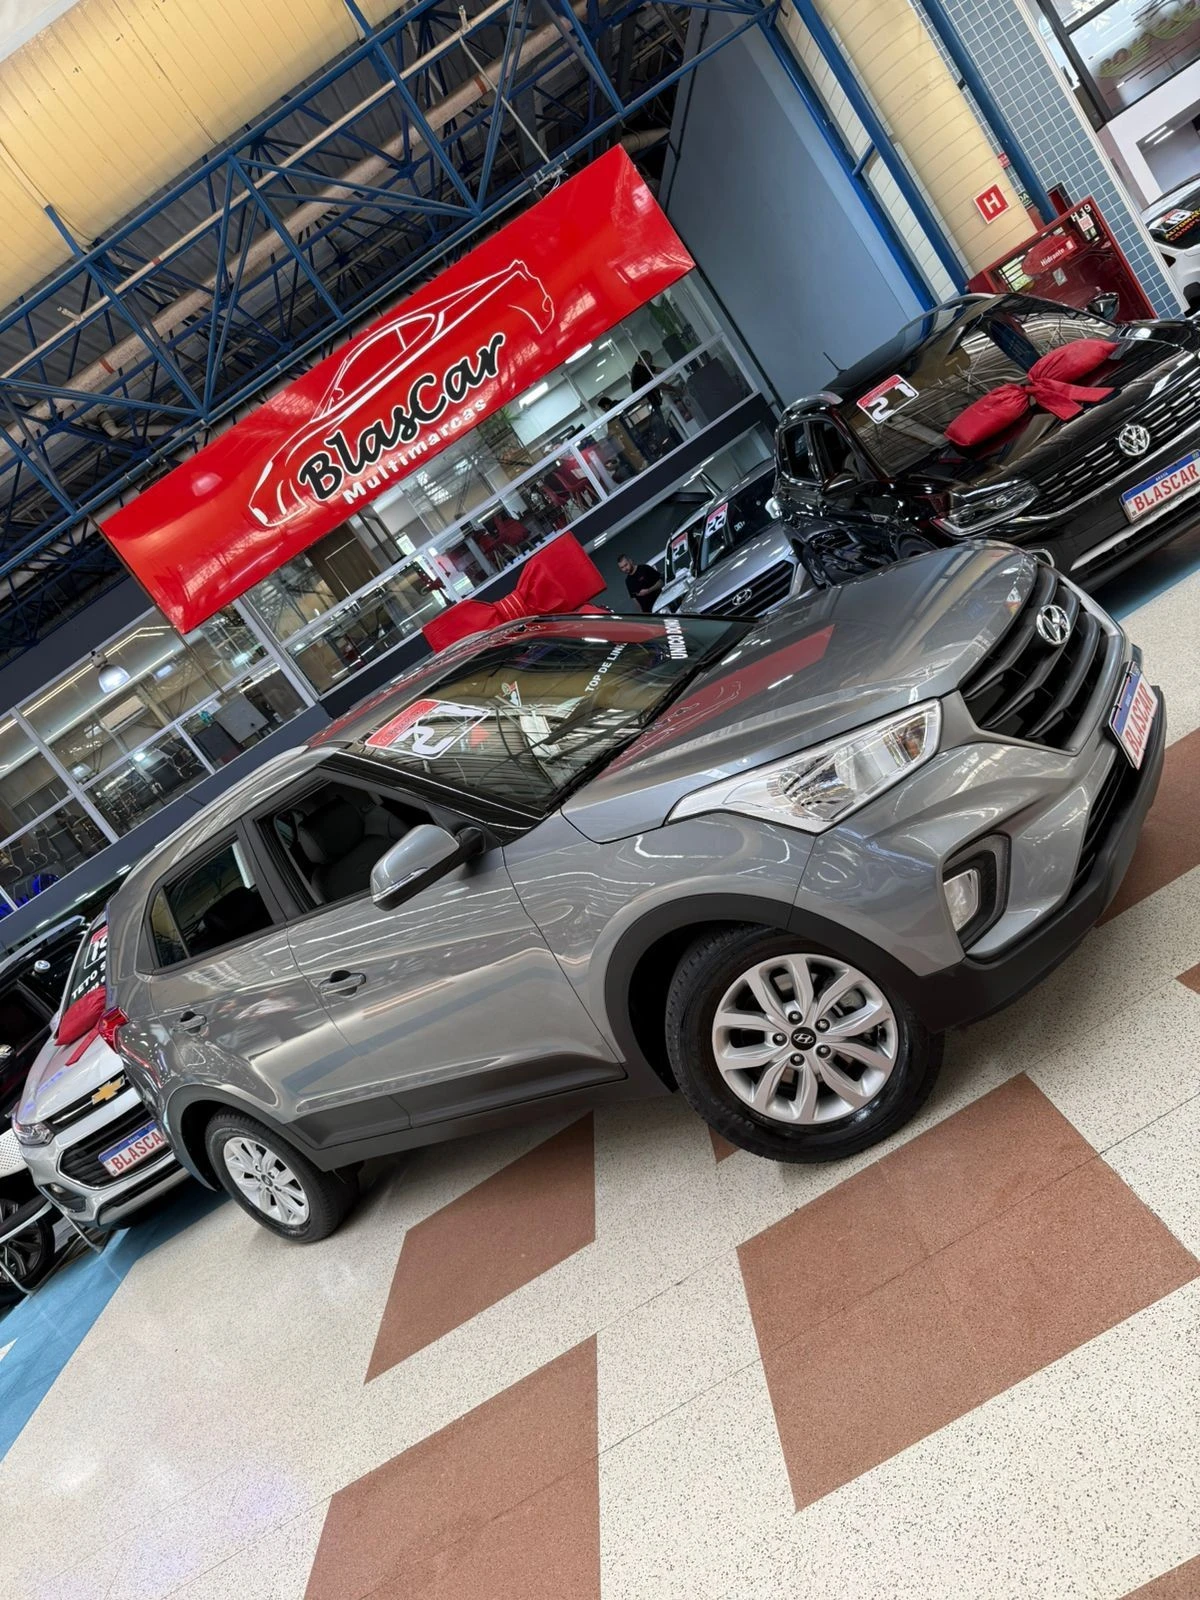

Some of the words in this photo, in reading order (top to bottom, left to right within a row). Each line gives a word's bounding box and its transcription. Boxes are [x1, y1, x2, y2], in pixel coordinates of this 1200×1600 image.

[983, 192, 1002, 214] H
[1041, 247, 1065, 267] Hidrante
[298, 332, 505, 501] BlasCar
[867, 382, 916, 421] 21
[342, 398, 487, 504] Multimarcas
[1133, 463, 1199, 511] BLASCAR
[666, 634, 688, 659] ÚNICO
[585, 674, 601, 693] TOP
[598, 661, 612, 674] DE
[392, 704, 485, 755] 21
[1125, 682, 1154, 757] BLASCAR
[71, 970, 98, 999] TETO
[111, 1132, 163, 1171] BLASCA
